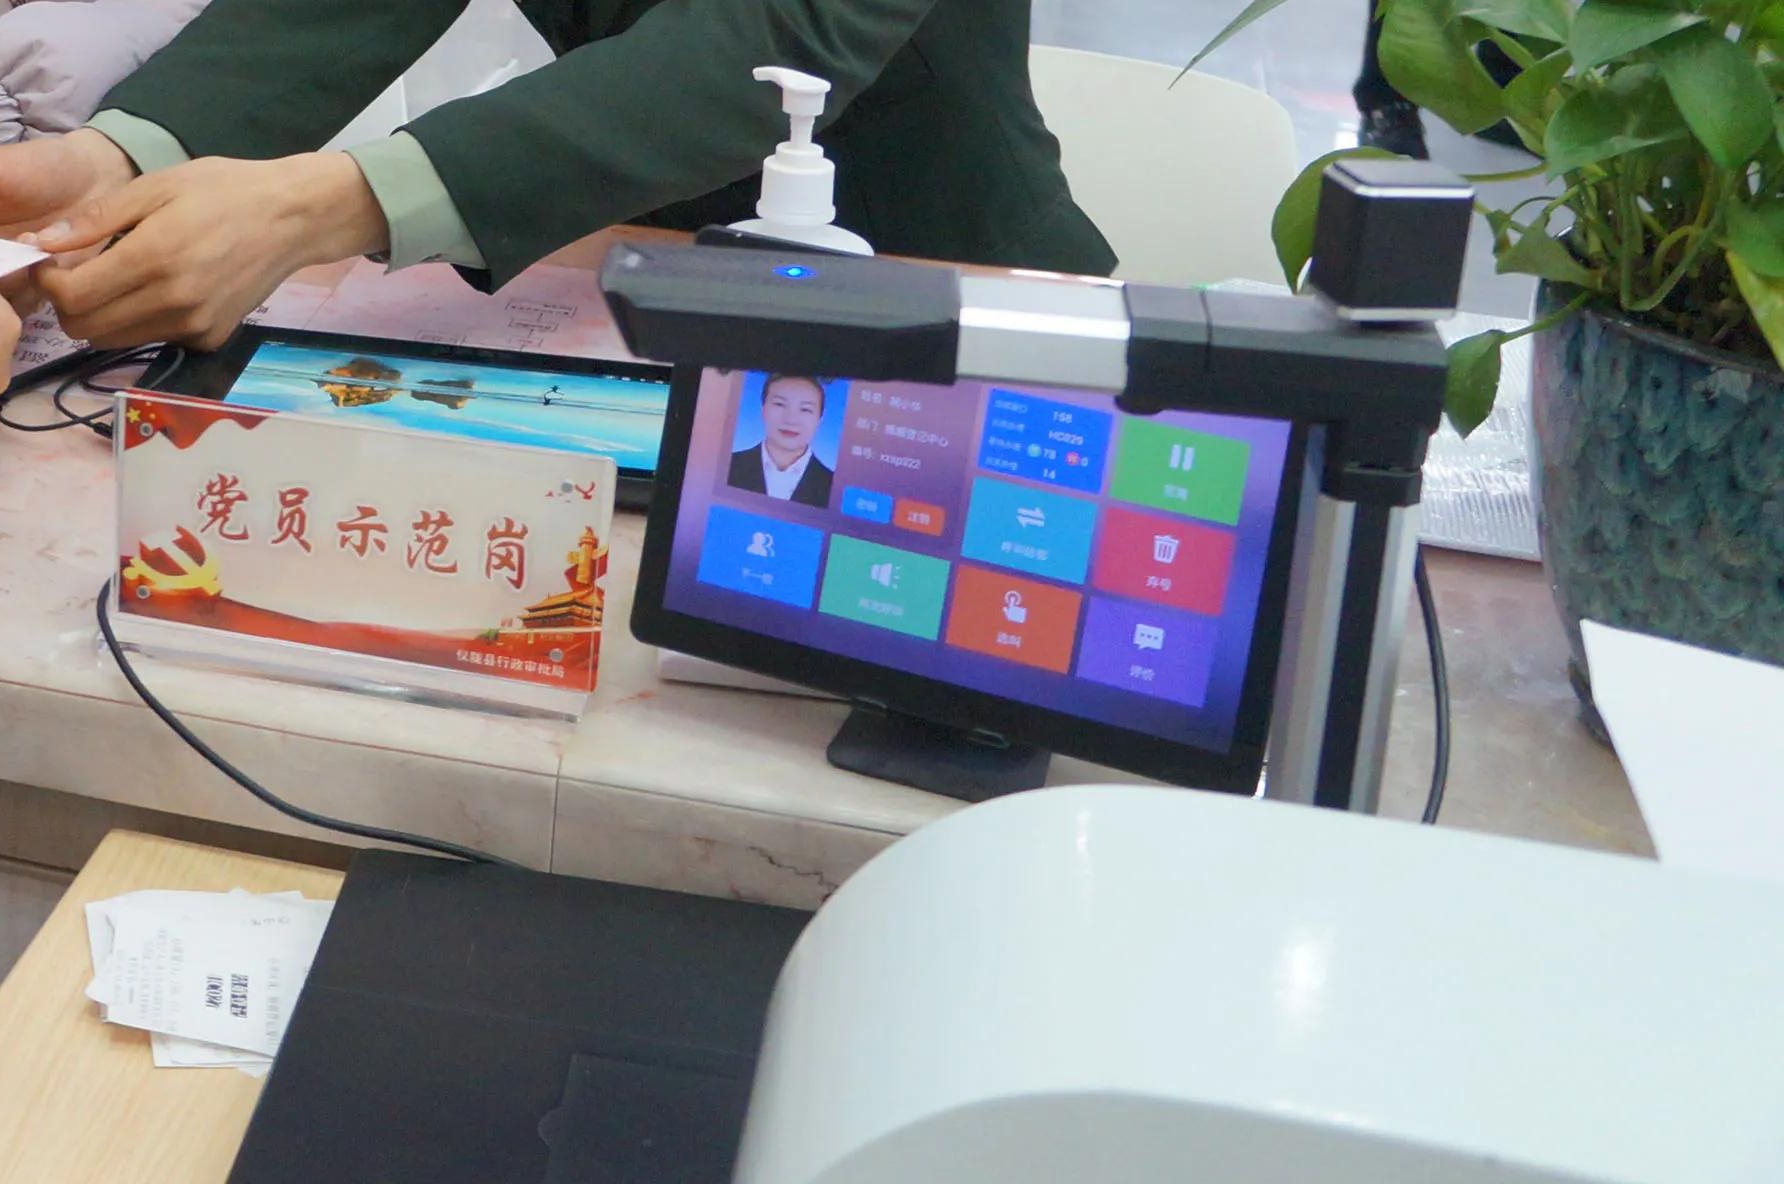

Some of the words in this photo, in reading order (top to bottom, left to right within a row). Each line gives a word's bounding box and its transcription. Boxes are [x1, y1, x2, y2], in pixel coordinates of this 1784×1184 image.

[196, 471, 530, 590] 党员示范岗
[456, 647, 566, 679] 仪陇县行政审批局
